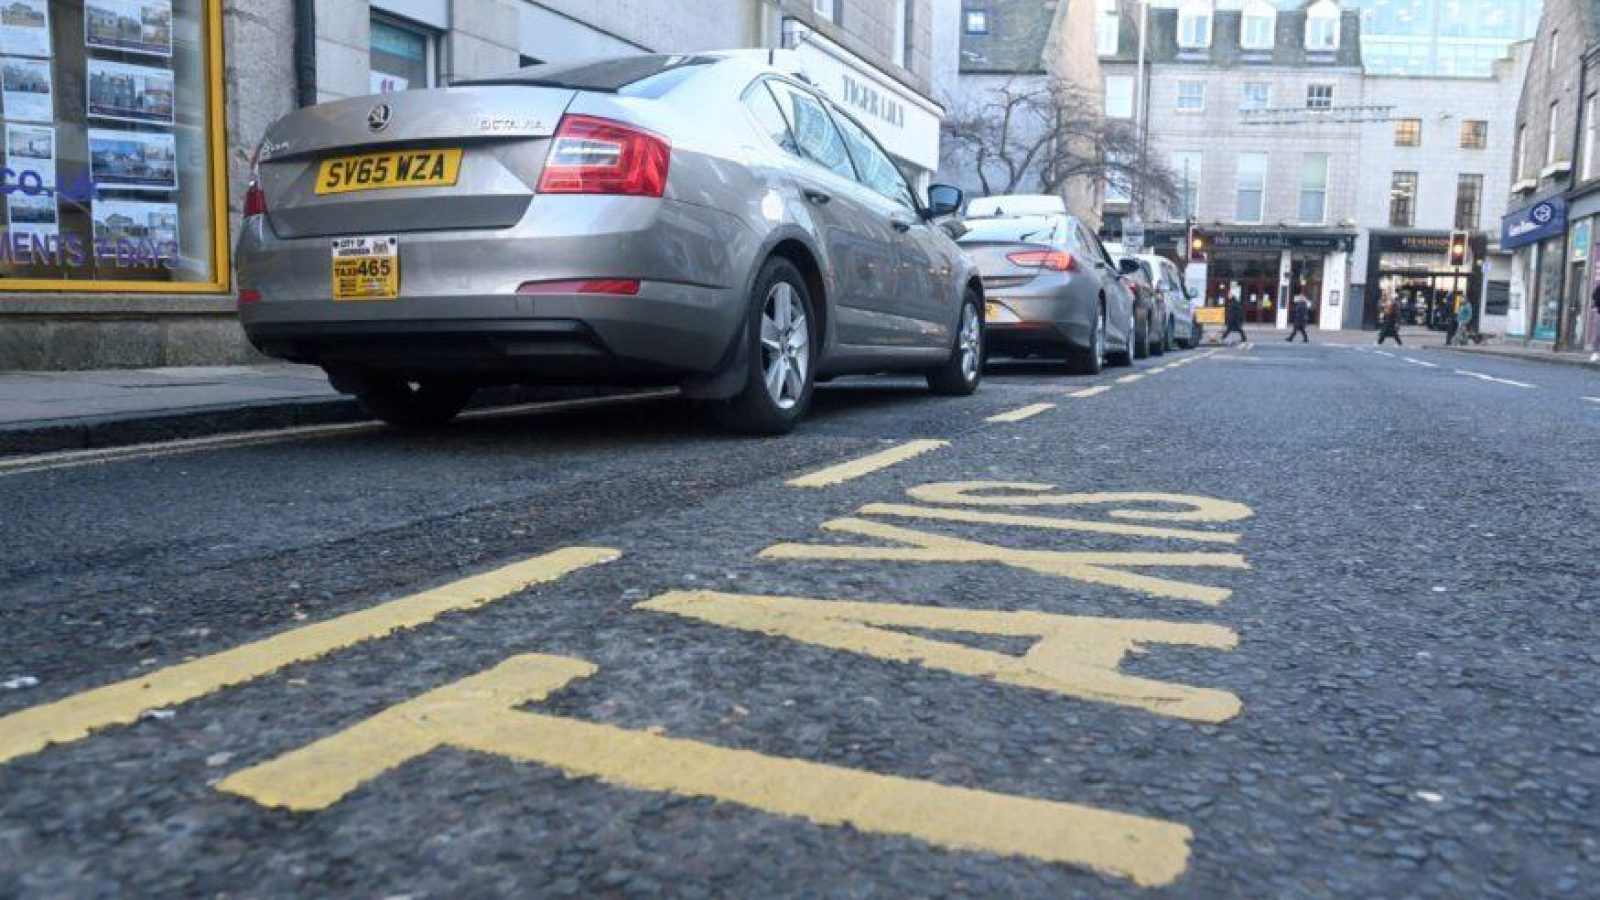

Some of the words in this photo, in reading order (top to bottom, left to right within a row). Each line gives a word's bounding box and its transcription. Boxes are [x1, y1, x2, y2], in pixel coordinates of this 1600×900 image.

[842, 74, 878, 117] TIGER
[881, 95, 904, 129] LILY
[325, 155, 392, 190] SV65
[395, 151, 444, 183] WZA
[358, 258, 391, 277] 465
[216, 480, 1253, 887] TAXIS
